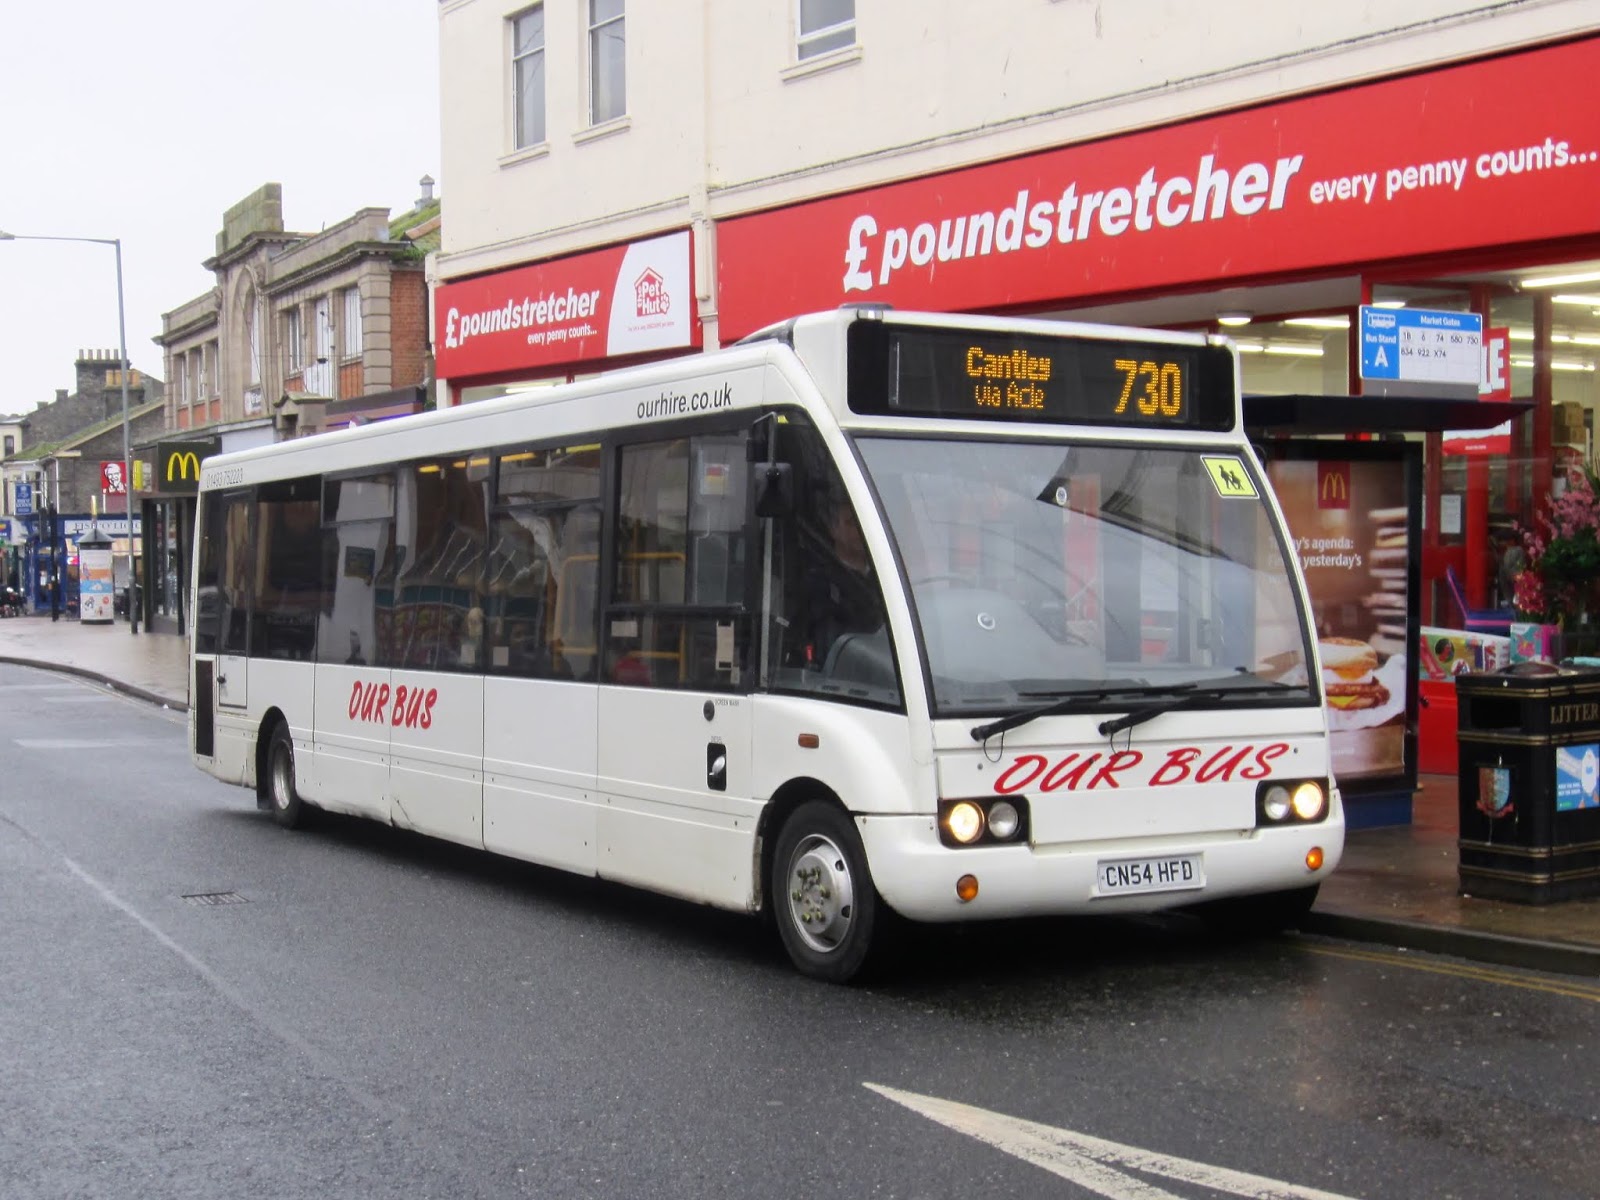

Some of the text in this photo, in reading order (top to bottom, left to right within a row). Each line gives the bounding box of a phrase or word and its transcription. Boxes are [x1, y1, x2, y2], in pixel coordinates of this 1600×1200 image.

[842, 137, 1598, 292] £ poundstretcher every penny counts...
[642, 279, 661, 299] Pet
[642, 296, 661, 315] Hut
[445, 287, 600, 349] £ poundstretcher
[1420, 315, 1461, 327] Market Gates
[527, 322, 598, 346] every penny counts...
[1365, 333, 1397, 345] Bus Stand
[1420, 333, 1427, 342] 6
[1436, 334, 1445, 343] 74
[1374, 345, 1389, 367] A
[1434, 350, 1446, 358] X74
[1480, 338, 1506, 394] LE
[966, 346, 1182, 416] Cantley 730
[636, 382, 733, 420] ourhire.co.uk
[975, 379, 1045, 410] via Acle
[1312, 536, 1354, 552] agenda:
[1303, 553, 1362, 571] yesterday's
[348, 680, 437, 730] OUR BUS
[1550, 703, 1599, 724] LITTER
[993, 743, 1290, 794] OUR BUS
[1105, 859, 1194, 888] CN54 HFD
